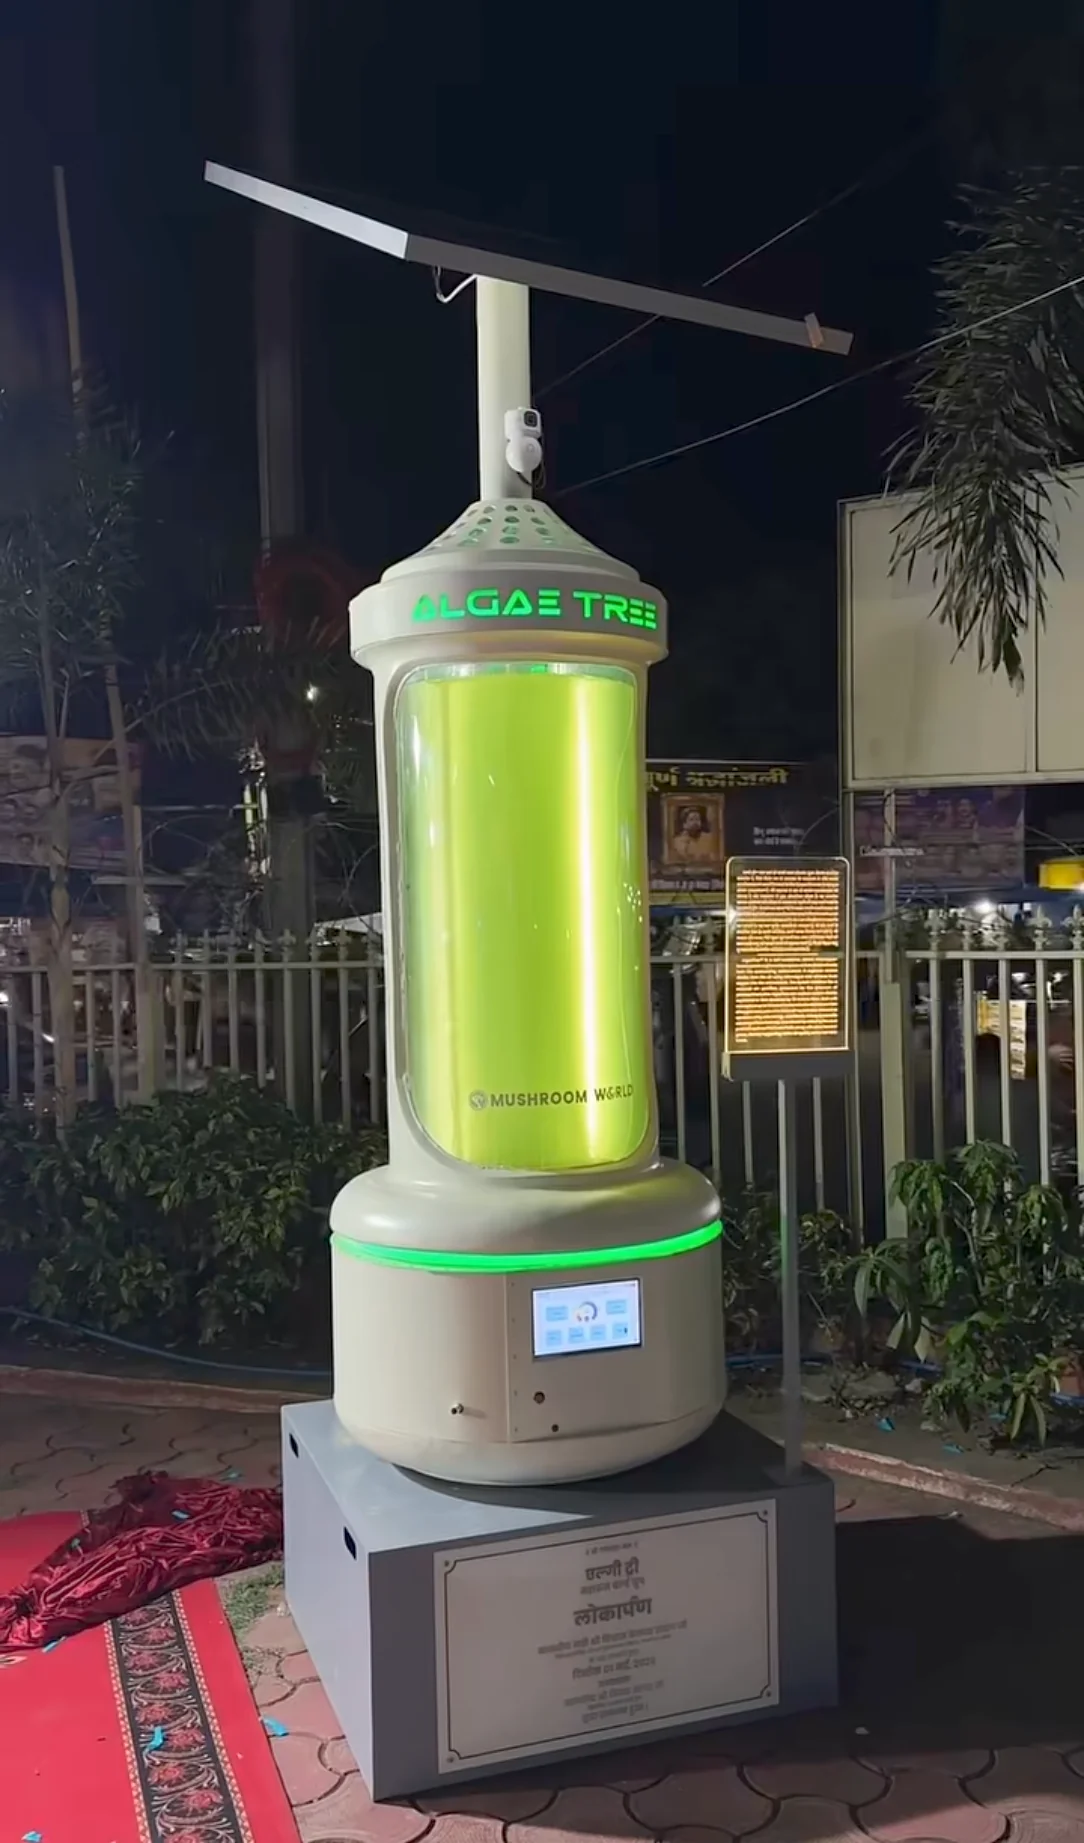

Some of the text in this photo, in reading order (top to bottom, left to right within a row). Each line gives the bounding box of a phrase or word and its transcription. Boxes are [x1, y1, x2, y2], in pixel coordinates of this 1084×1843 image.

[411, 588, 657, 630] ALGAE TREE
[490, 1090, 588, 1107] MUSHROOM
[573, 1595, 653, 1626] लोकार्पण
